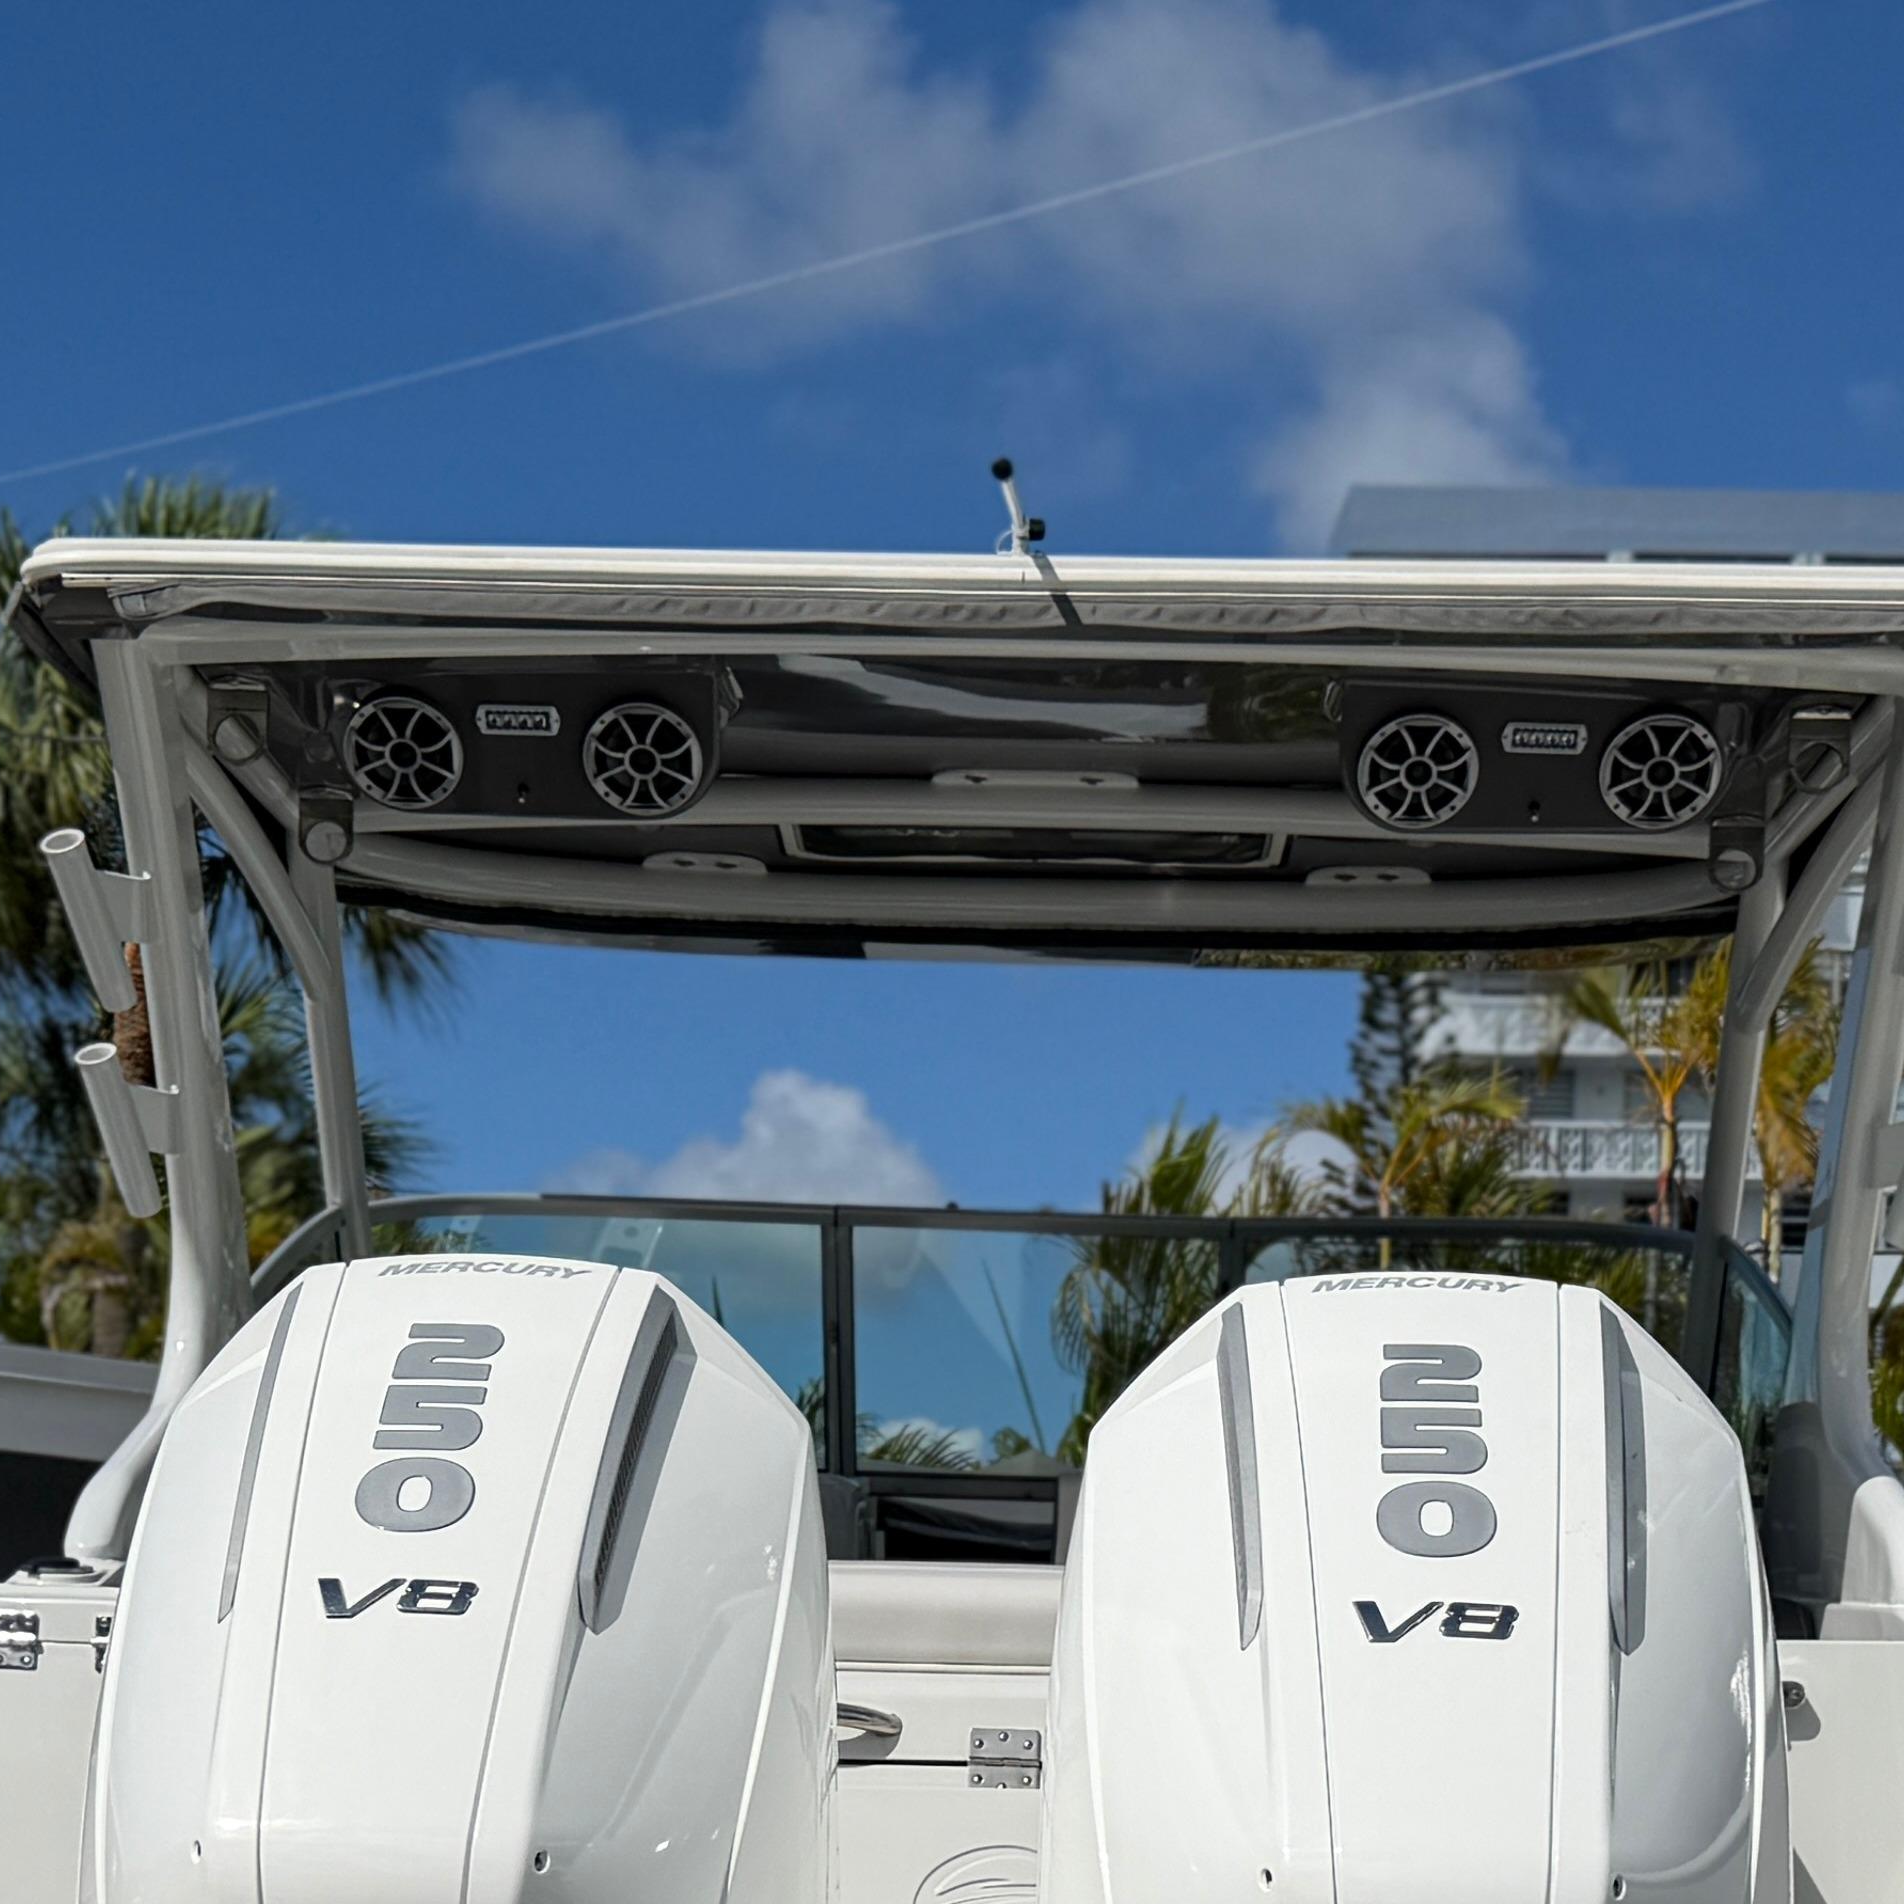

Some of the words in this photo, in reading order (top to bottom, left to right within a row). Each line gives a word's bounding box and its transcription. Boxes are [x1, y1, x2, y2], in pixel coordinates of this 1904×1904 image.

[377, 1261, 593, 1279] MERCURY
[1311, 1276, 1524, 1293] MERCURY
[355, 1323, 505, 1532] 250
[1376, 1344, 1497, 1557] 250
[318, 1578, 480, 1619] V8
[1351, 1600, 1520, 1643] V8
